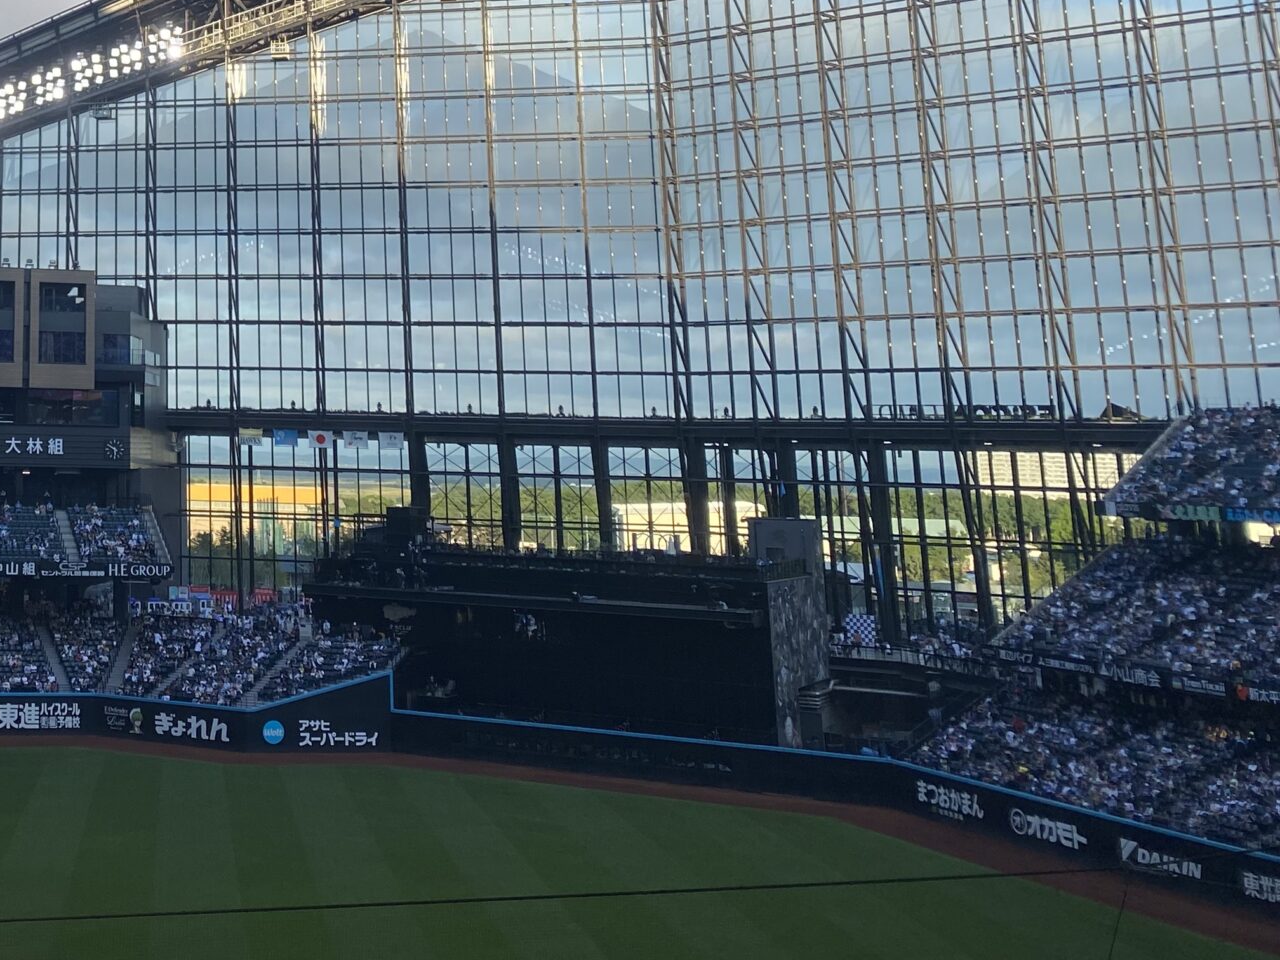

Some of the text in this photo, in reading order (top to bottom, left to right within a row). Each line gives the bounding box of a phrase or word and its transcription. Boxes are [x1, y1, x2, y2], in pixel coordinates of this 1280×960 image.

[4, 436, 65, 455] 大林組
[58, 561, 88, 571] CSP
[130, 563, 171, 578] GROUP
[39, 702, 81, 716] ハイスクール
[154, 711, 230, 743] ぎょれん
[262, 726, 284, 739] Wolt
[298, 718, 331, 732] アサヒ
[298, 731, 379, 747] スーパードライ
[916, 778, 985, 820] まつおかまん
[1026, 814, 1089, 851] オカモト
[1137, 847, 1203, 881] DAIKIN
